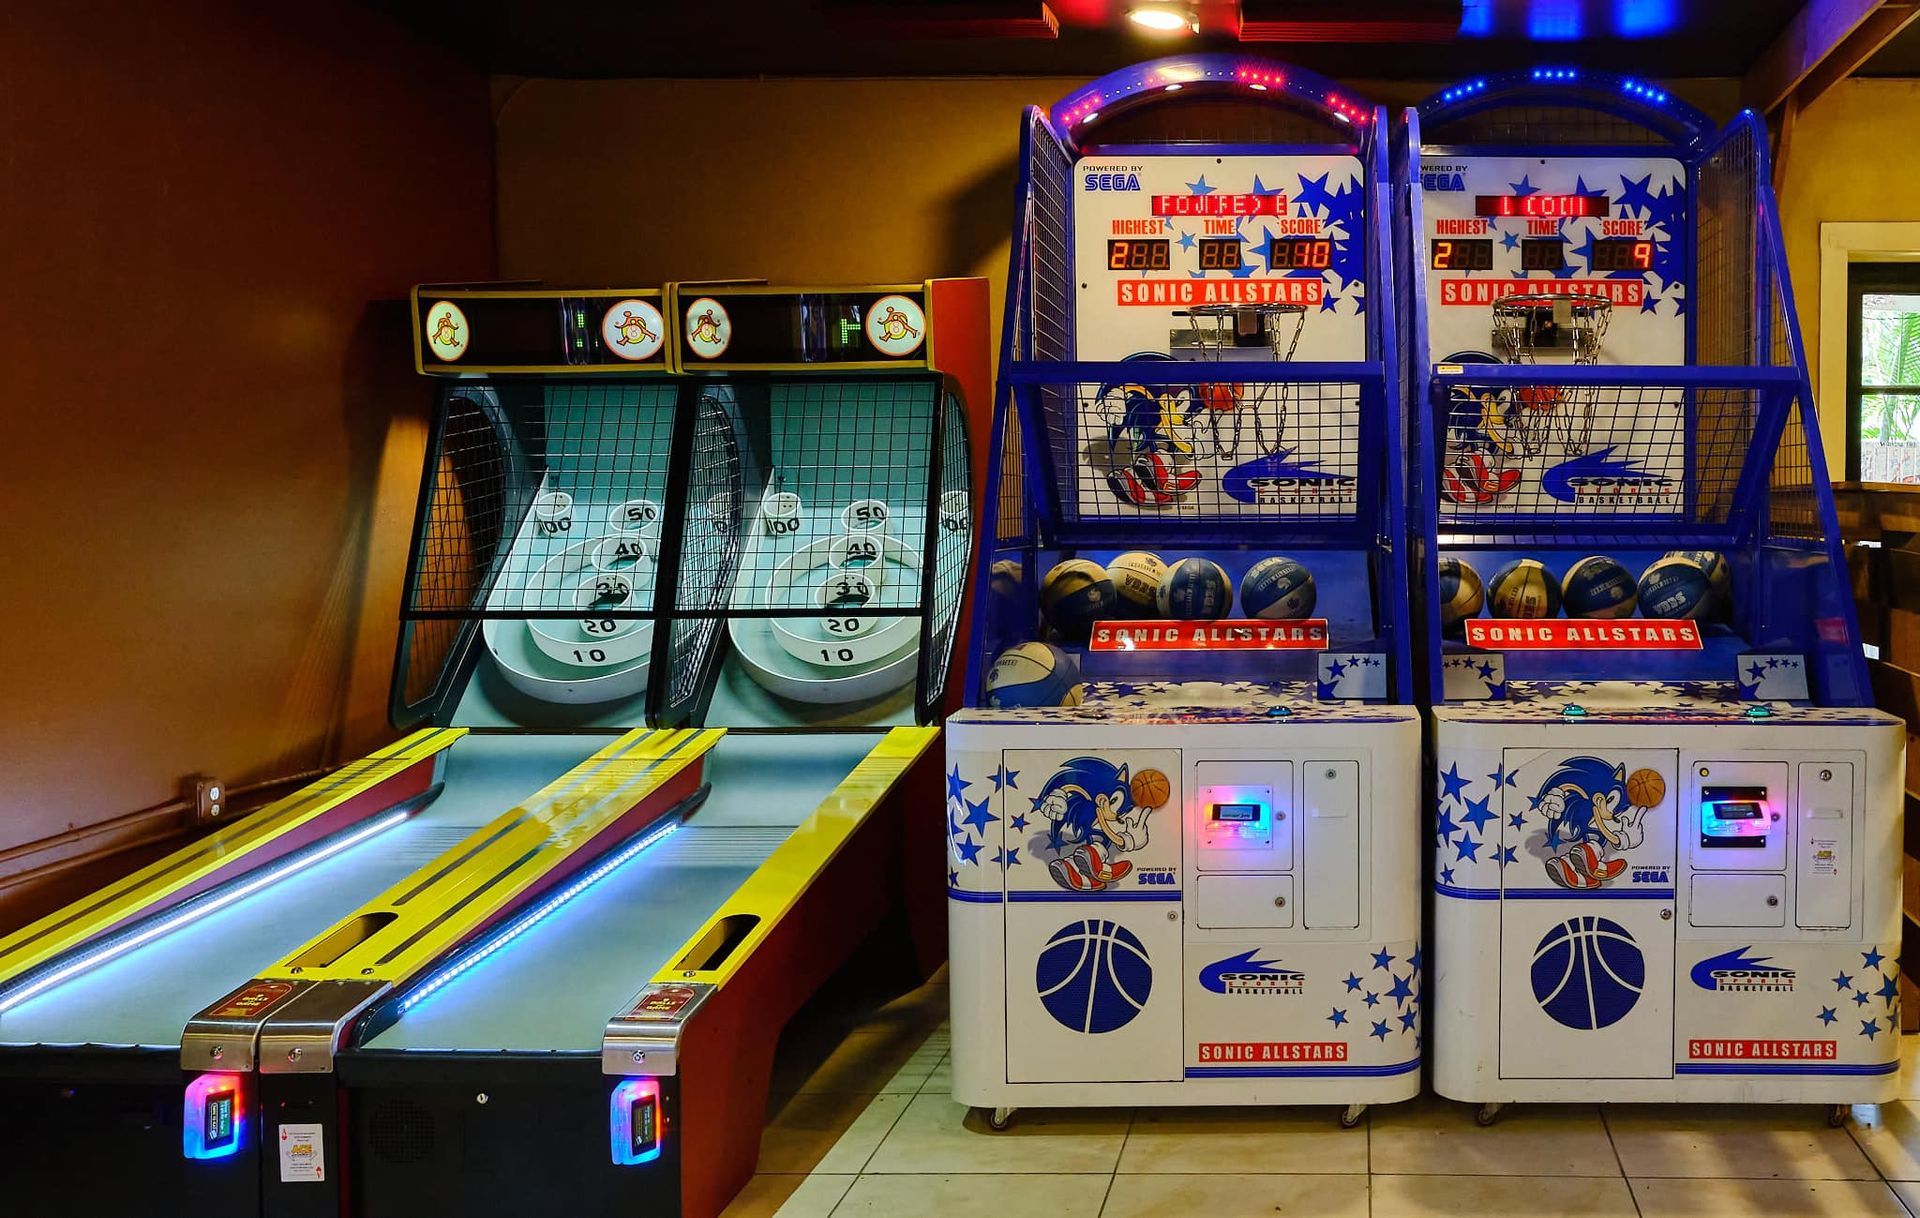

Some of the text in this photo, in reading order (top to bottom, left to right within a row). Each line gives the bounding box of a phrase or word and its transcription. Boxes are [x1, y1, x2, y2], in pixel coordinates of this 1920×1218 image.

[1085, 174, 1141, 191] SEGA
[1421, 173, 1466, 191] EGA
[1112, 218, 1321, 235] HIGHEST TIME SCORE
[1436, 219, 1643, 236] HIGHEST TIME SCORE
[1634, 243, 1651, 268] 9
[1121, 282, 1319, 303] SONIC ALLSTARS
[1444, 283, 1516, 303] SONIC
[1250, 479, 1356, 487] SONIC
[1570, 478, 1673, 487] SONIC
[1578, 496, 1671, 504] BASKETBALL
[627, 507, 656, 522] 50
[856, 507, 887, 521] 50
[768, 517, 800, 534] 100
[615, 543, 643, 555] 40
[848, 542, 876, 555] 40
[836, 582, 869, 596] 30
[585, 619, 617, 634] 20
[828, 618, 860, 633] 20
[1097, 627, 1323, 643] SONIC ALLSTARS
[1471, 626, 1695, 642] SONIC ALLSTARS
[573, 649, 606, 663] 10
[820, 648, 854, 662] 10
[1138, 873, 1177, 885] SEGA
[1632, 871, 1669, 883] SEGA
[1202, 1045, 1345, 1060] SONIC ALLSTARS
[1692, 1042, 1834, 1056] SONIC ALLSTARS
